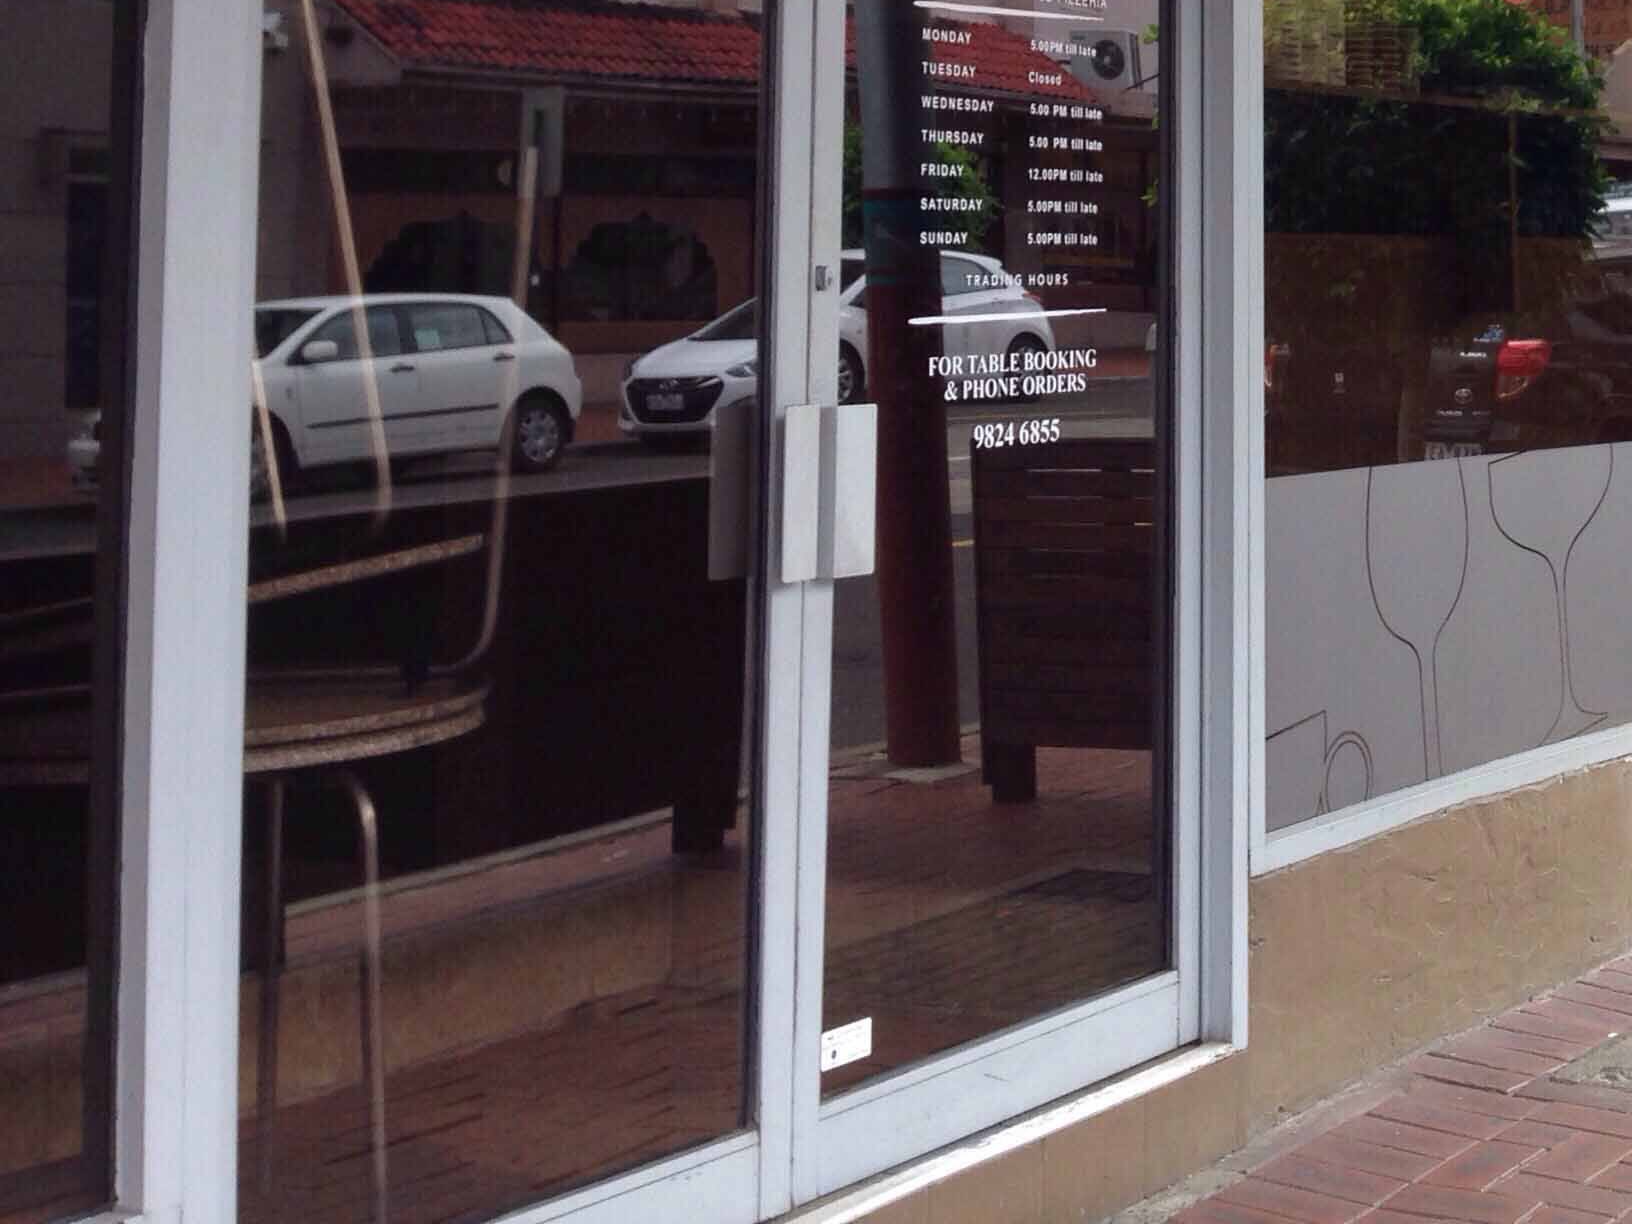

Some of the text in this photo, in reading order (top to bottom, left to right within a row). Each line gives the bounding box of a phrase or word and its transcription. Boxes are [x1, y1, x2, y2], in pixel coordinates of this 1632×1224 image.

[922, 28, 972, 45] MONDAY
[1065, 41, 1077, 55] till
[1078, 43, 1097, 58] late
[922, 62, 1062, 86] TUESDAY Closed
[921, 96, 994, 113] WEDNESDAY
[1053, 105, 1068, 118] PM
[1070, 106, 1084, 118] till
[1085, 108, 1102, 120] late
[921, 129, 984, 145] THURSDAY
[1053, 137, 1068, 150] PM
[1070, 138, 1084, 151] till
[1085, 139, 1103, 152] late
[920, 163, 965, 177] FRIDAY
[1070, 169, 1083, 182] till
[1084, 170, 1103, 183] late
[920, 198, 983, 212] SATURDAY
[1064, 201, 1078, 214] till
[1079, 201, 1098, 215] late
[920, 232, 968, 245] SUNDAY
[1064, 232, 1078, 245] till
[1079, 233, 1098, 246] late
[966, 273, 1069, 287] TRADING HOURS
[928, 349, 1097, 377] FOR TABLE BOOKING
[944, 373, 1086, 401] & PHONE ORDERS
[973, 419, 1061, 449] 9824 6855
